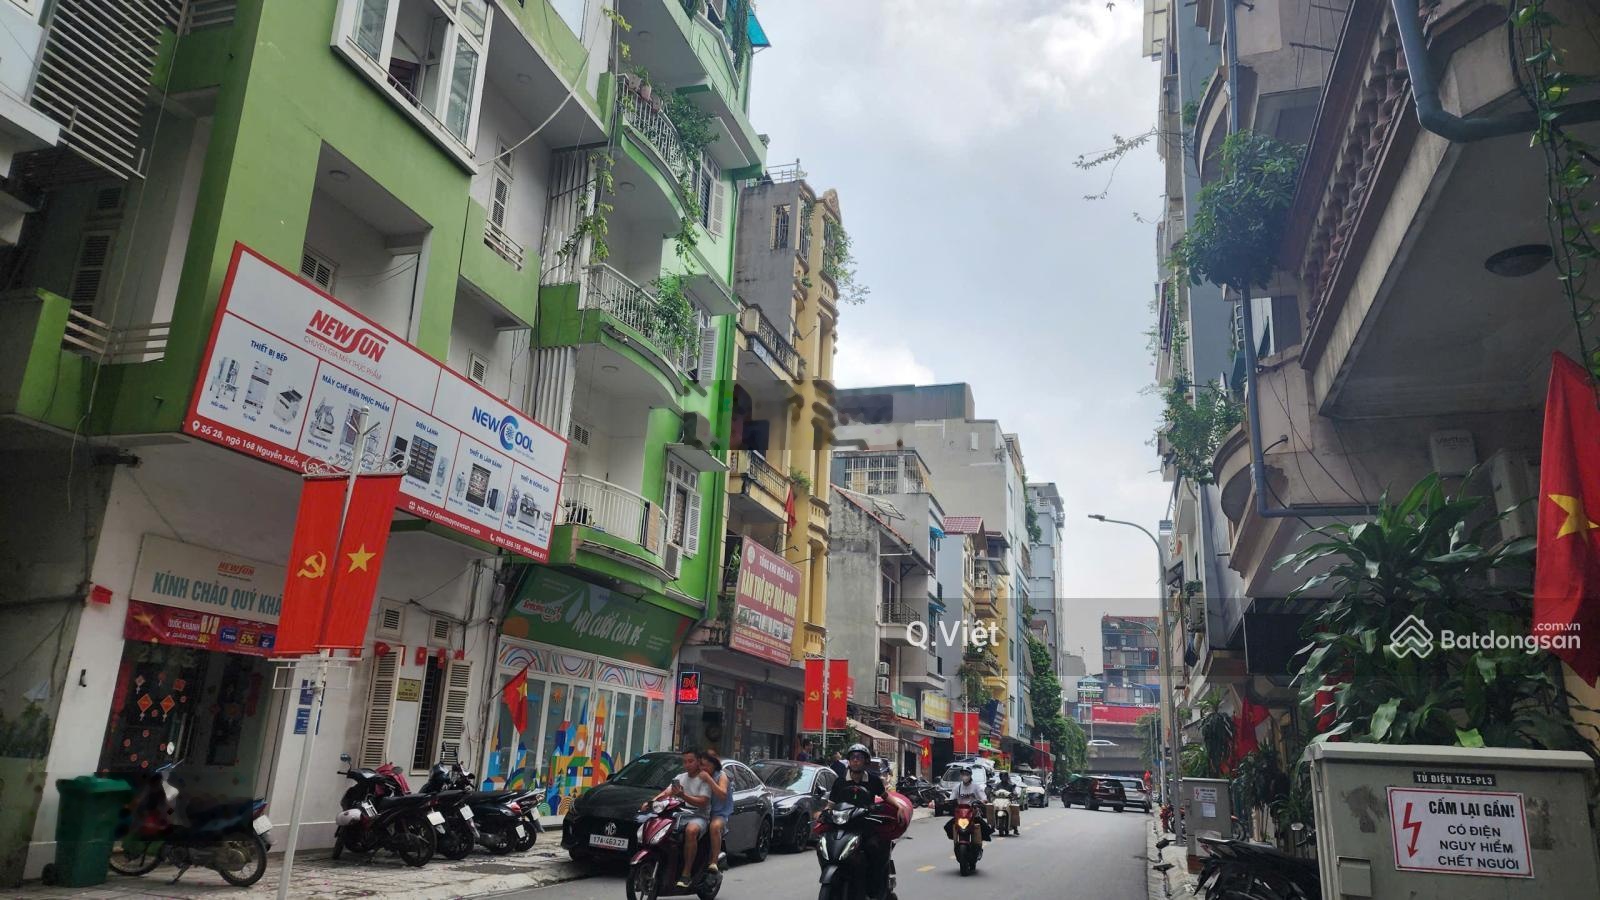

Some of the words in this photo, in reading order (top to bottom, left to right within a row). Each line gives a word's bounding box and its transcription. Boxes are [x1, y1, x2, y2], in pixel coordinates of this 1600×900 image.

[305, 309, 389, 363] NEWSUN
[250, 340, 268, 354] THIẾT
[268, 349, 277, 359] BỊ
[275, 353, 288, 362] BẾP
[322, 375, 336, 386] MÁY
[335, 381, 348, 392] CHẾ
[348, 387, 360, 397] BIẾN
[360, 393, 375, 405] THỰC
[374, 400, 390, 412] PHẨM
[472, 406, 534, 454] NEWCOOL
[201, 424, 212, 435] Số
[212, 429, 224, 441] 28,
[225, 434, 241, 446] ngõ
[242, 441, 256, 451] 168
[256, 445, 283, 462] Nguyễn
[152, 570, 189, 601] KÍNH
[191, 580, 228, 606] CHÀO
[231, 587, 258, 612] QUÝ
[258, 593, 282, 617] KHÁ
[240, 633, 254, 644] 5%
[1416, 773, 1428, 783] TỦ
[1431, 774, 1453, 785] ĐIỆN
[1455, 775, 1494, 785] TX5-PL3
[1428, 796, 1458, 816] CẤM
[1461, 801, 1481, 820] LẠI
[1484, 799, 1516, 819] GẦN!
[1448, 823, 1467, 836] CÓ
[1470, 825, 1502, 839] ĐIỆN
[1439, 840, 1477, 852] NGUY
[1480, 838, 1514, 854] HIỂM
[1438, 853, 1474, 867] CHẾT
[1477, 857, 1520, 871] NGƯỜI
